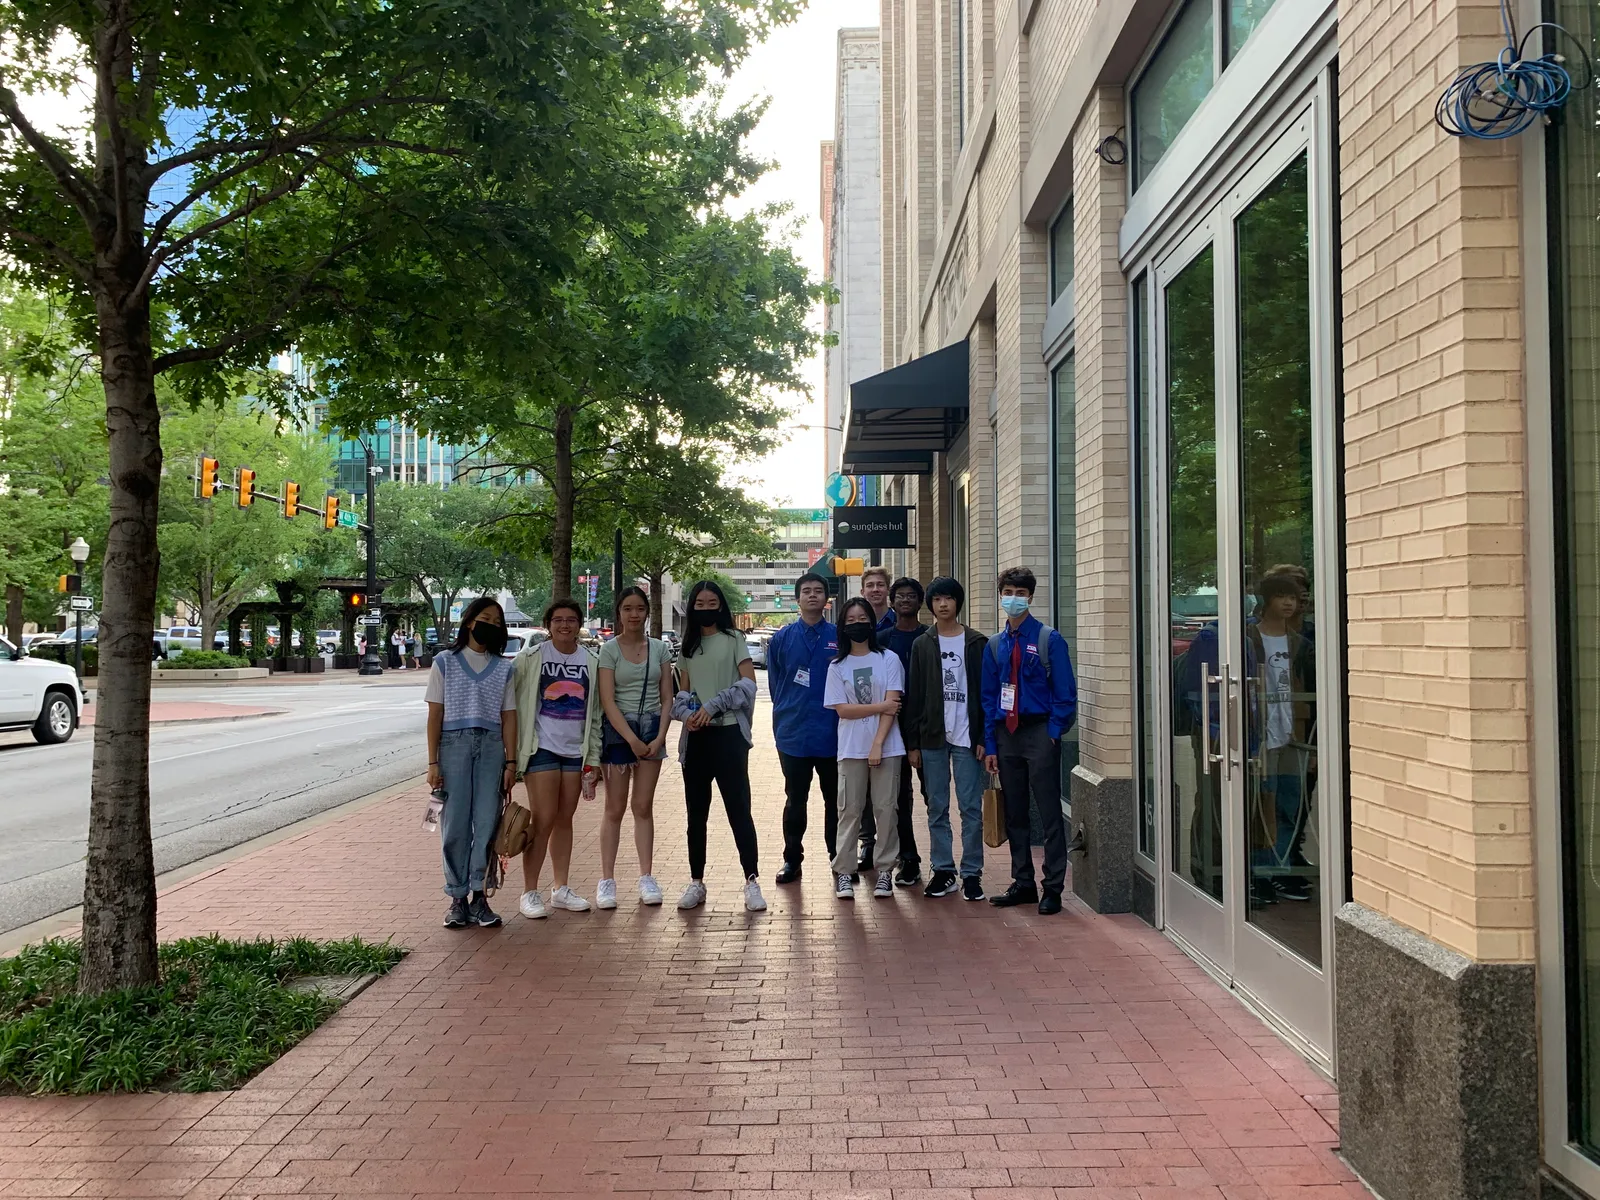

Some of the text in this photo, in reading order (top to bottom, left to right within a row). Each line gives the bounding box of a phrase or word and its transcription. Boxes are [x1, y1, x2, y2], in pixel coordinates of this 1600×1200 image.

[818, 509, 828, 518] St
[851, 522, 903, 533] sunglass hut
[541, 662, 589, 679] NASA
